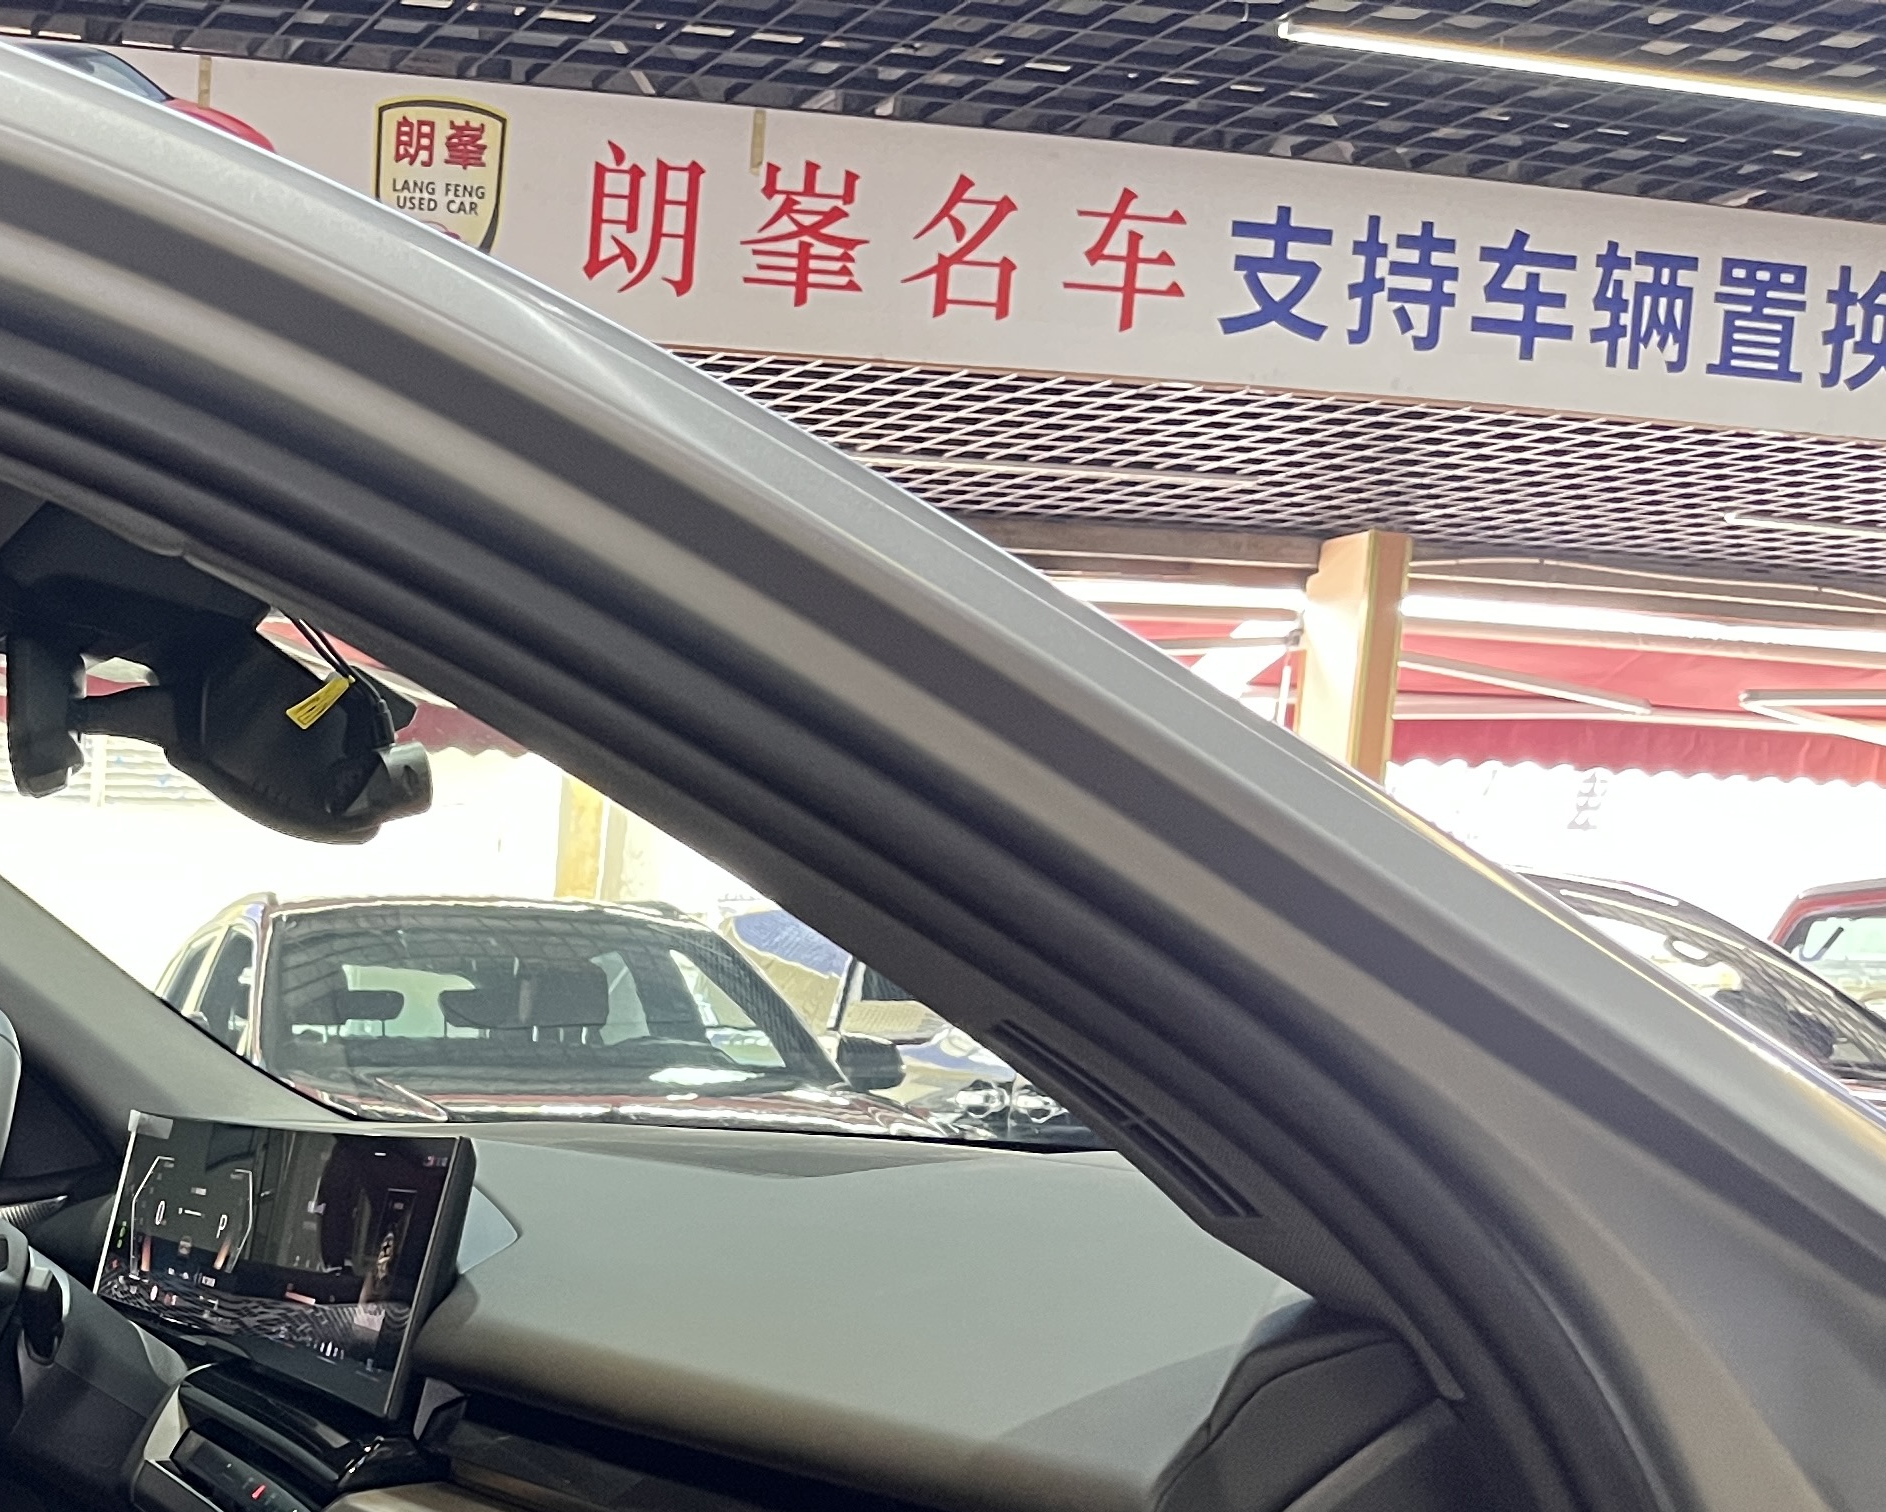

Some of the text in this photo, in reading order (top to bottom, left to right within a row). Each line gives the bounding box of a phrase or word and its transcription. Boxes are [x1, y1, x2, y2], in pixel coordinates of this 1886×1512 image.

[394, 115, 488, 170] 朗峯
[392, 178, 486, 200] LANG FENG
[396, 195, 479, 216] USED CAR
[583, 139, 1886, 392] 朗峯名车 支持车辆置换
